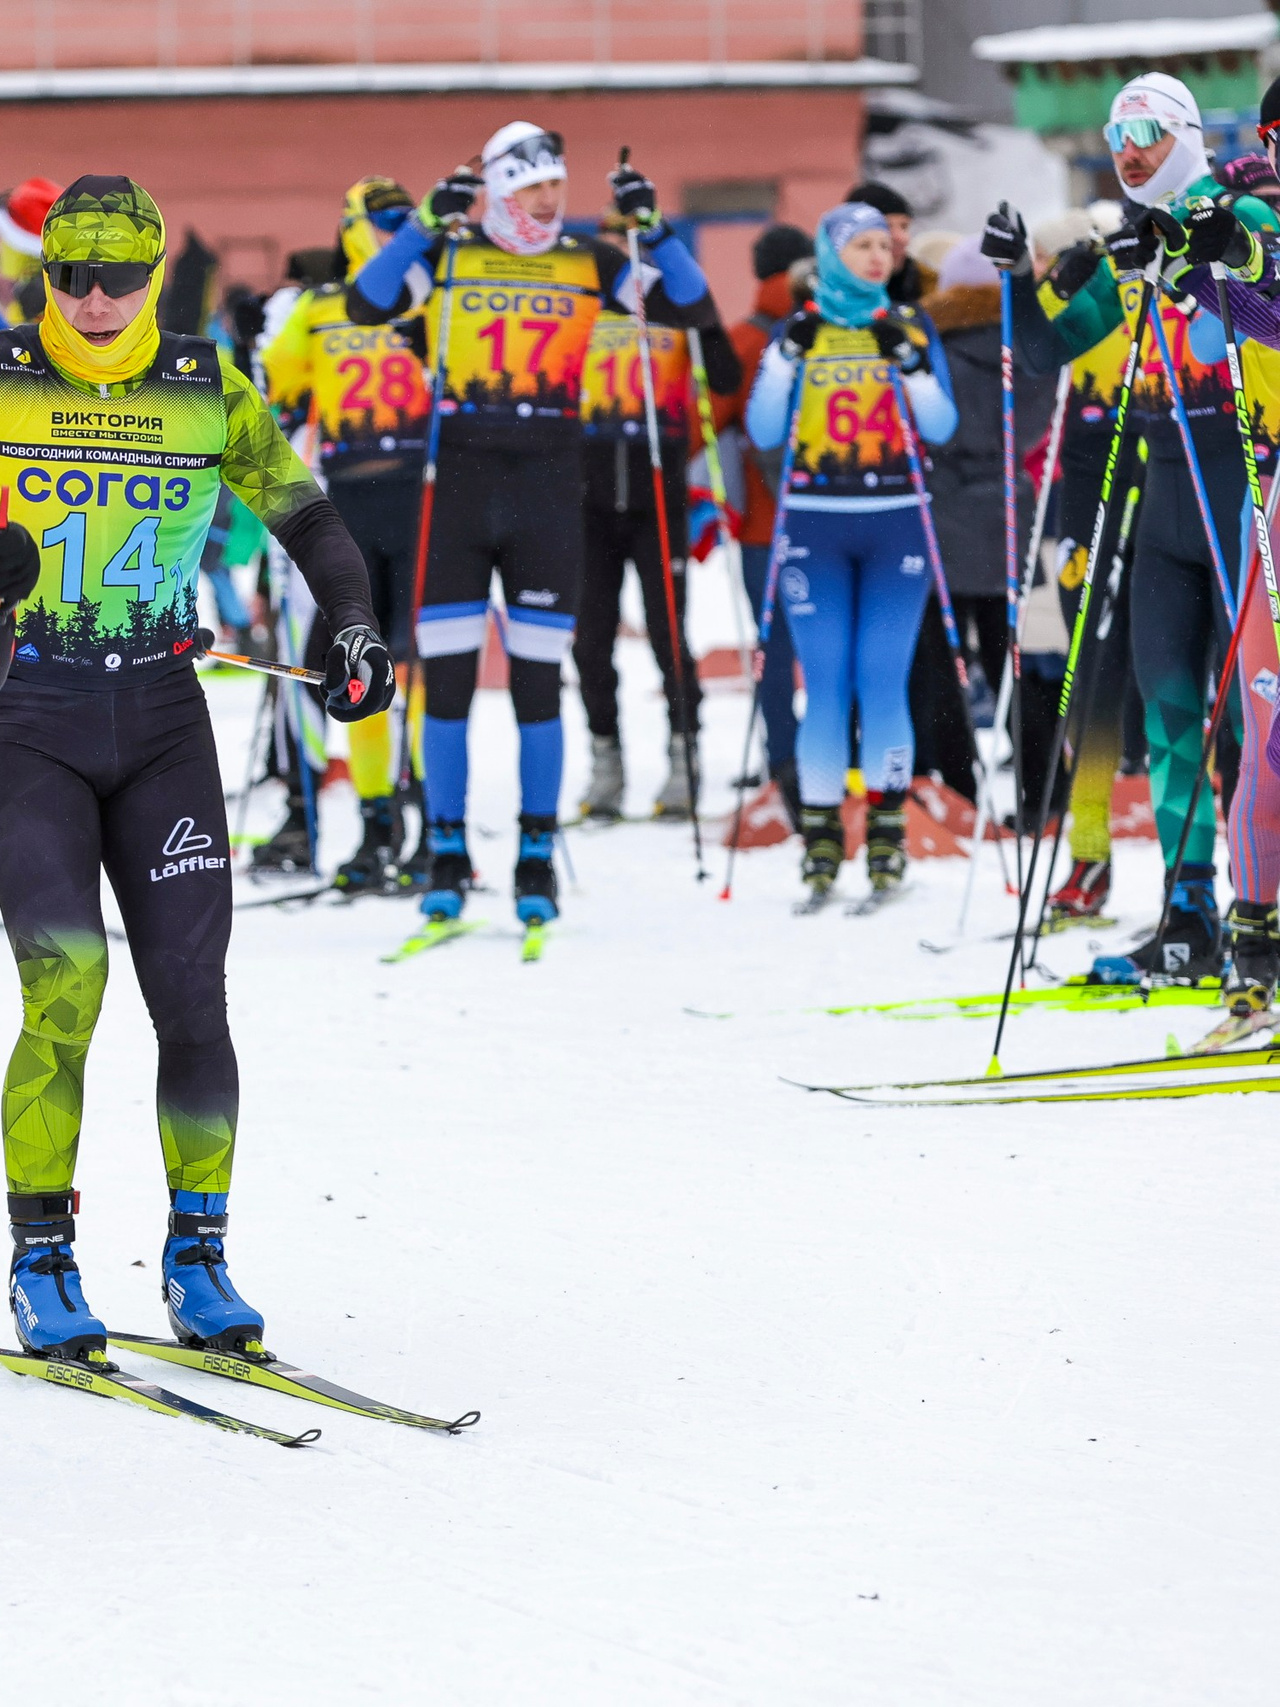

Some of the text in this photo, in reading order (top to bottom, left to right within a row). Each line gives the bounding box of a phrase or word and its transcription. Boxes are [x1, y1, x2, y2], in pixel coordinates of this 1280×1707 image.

[478, 316, 560, 375] 17
[337, 354, 414, 411] 28
[810, 364, 889, 387] сога
[51, 411, 163, 431] ВИКТОРИЯ
[827, 389, 896, 444] 64
[52, 429, 162, 443] вместе мы строим
[2, 444, 207, 468] НОВОГОДНИЙ КОМАНДНЫЙ СПРИНТ
[42, 511, 165, 603] 14
[132, 650, 168, 666] DIWARI
[25, 1233, 65, 1245] SPINE
[14, 1284, 40, 1330] SPINE
[45, 1364, 94, 1390] FISCHER
[203, 1354, 251, 1380] FISCHER
